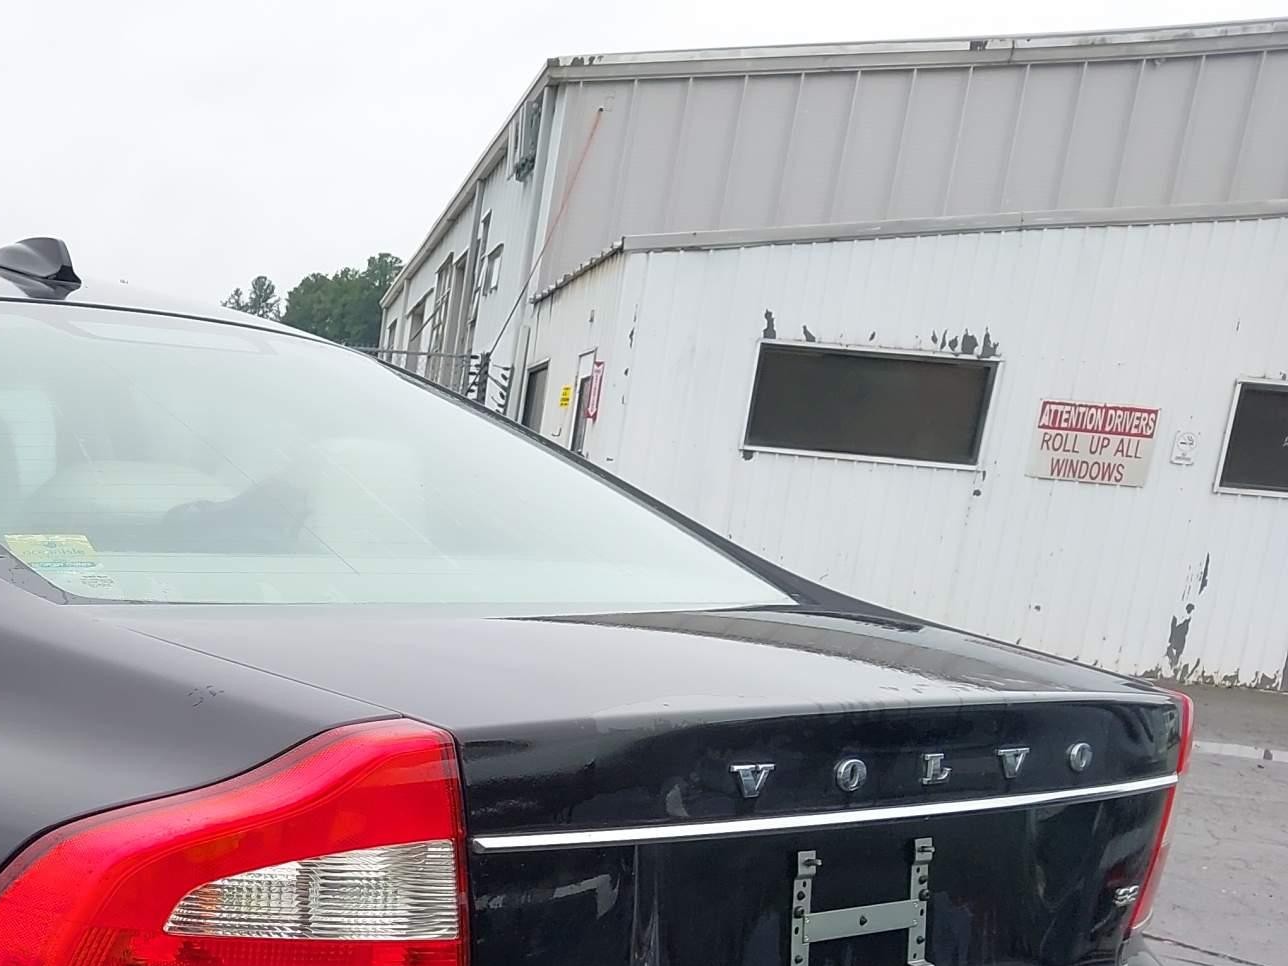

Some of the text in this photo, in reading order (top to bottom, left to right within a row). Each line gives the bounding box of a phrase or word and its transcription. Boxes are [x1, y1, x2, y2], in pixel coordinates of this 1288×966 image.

[1040, 404, 1156, 435] ATTENTION DRIVERS
[1040, 432, 1142, 459] ROLL UP ALL
[1050, 458, 1125, 482] WINDOWS
[729, 740, 1093, 798] VOLVO
